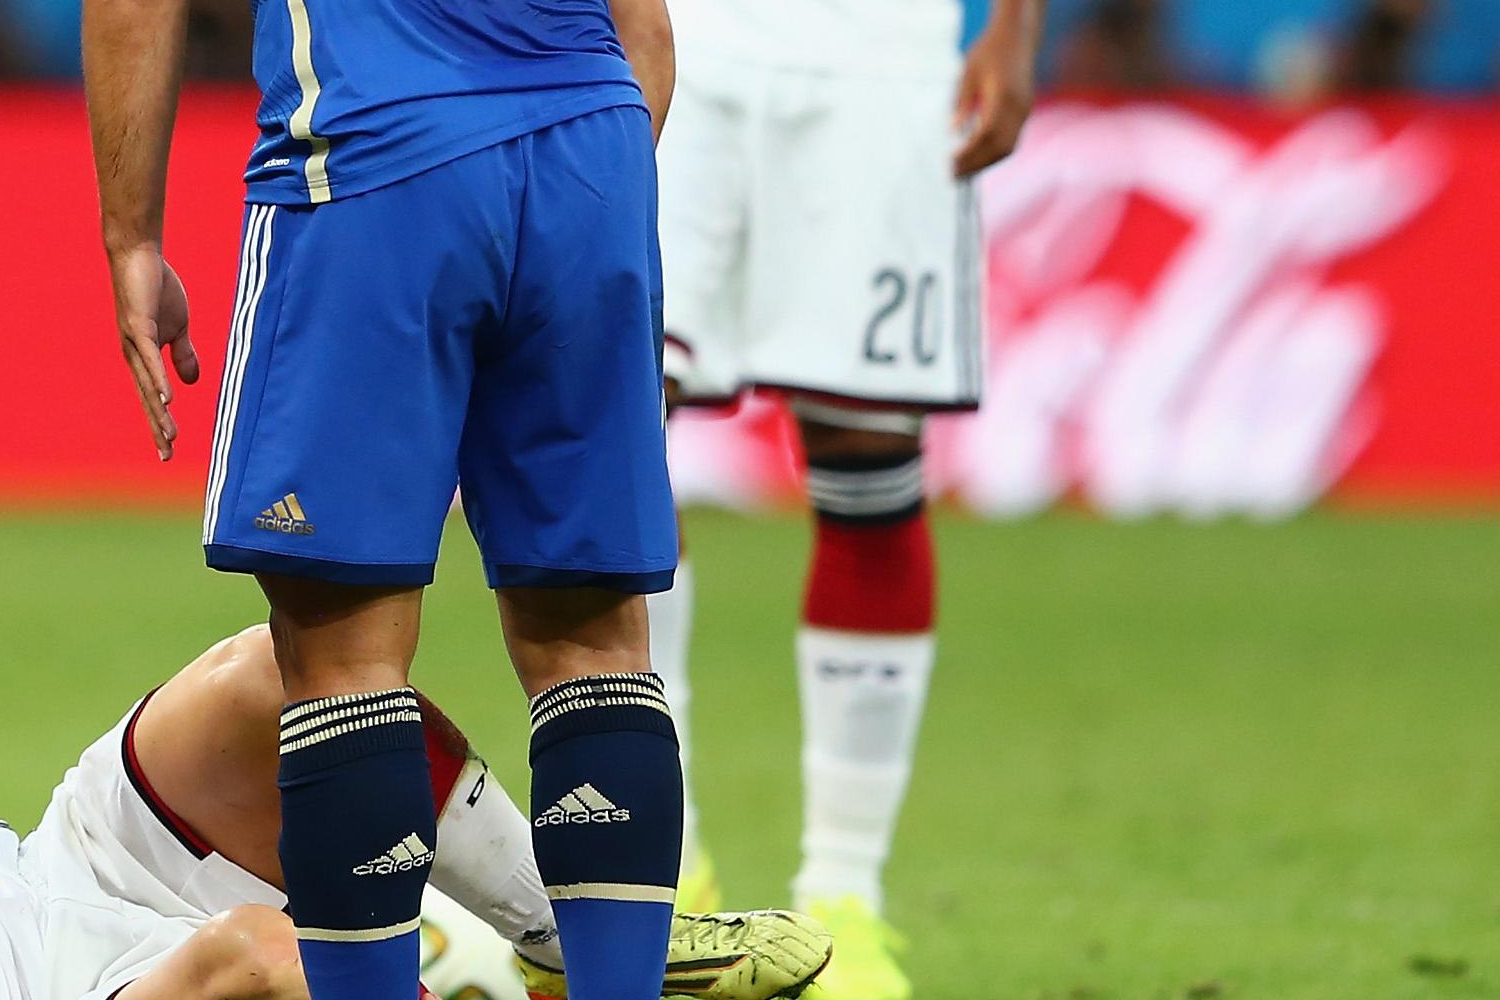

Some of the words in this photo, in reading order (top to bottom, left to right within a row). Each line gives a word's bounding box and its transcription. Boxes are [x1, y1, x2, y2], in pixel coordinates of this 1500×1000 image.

[863, 267, 938, 366] 20
[255, 517, 315, 535] adidas
[534, 808, 631, 827] adidas
[352, 850, 435, 876] adidas
